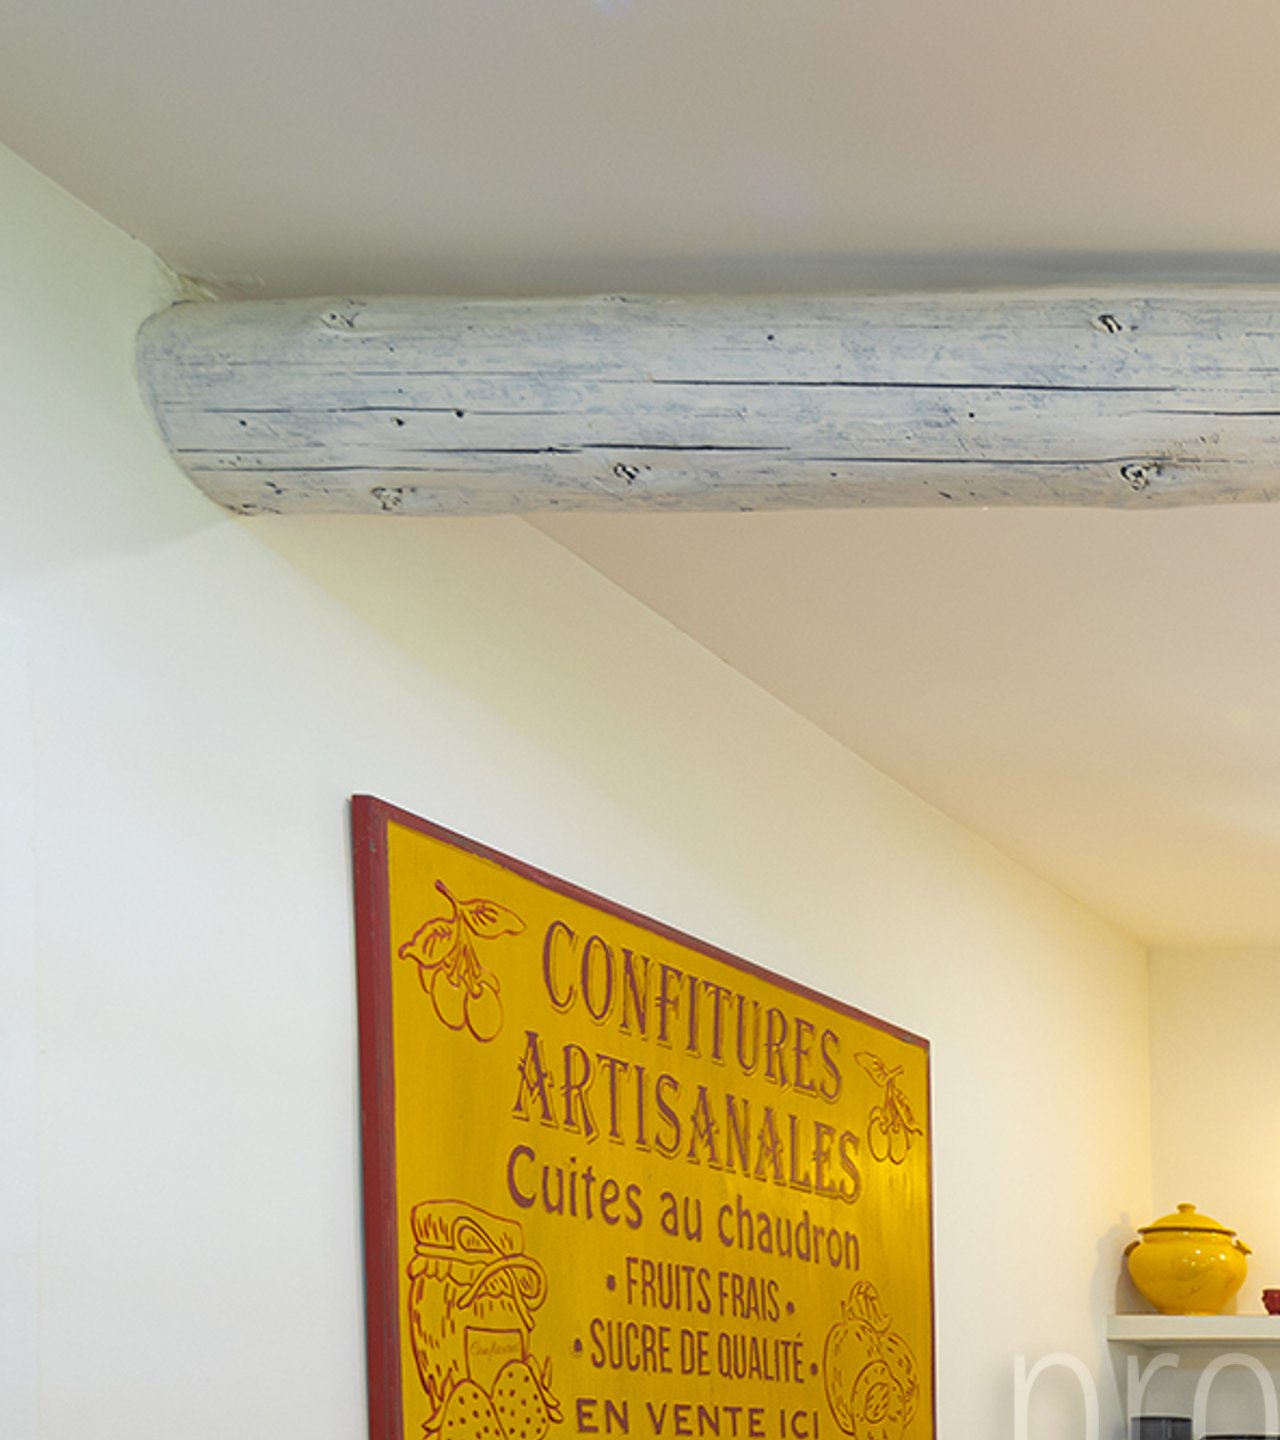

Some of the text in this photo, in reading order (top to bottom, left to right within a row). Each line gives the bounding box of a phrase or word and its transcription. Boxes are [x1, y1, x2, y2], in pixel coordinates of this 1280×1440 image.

[542, 920, 843, 1104] CONFITURES
[511, 1030, 863, 1204] ARTISANALES
[507, 1145, 860, 1272] Cuites au chaudron
[626, 1257, 781, 1322] FRUITS FRAIS
[589, 1318, 805, 1385] SUCRE DE QUALITÉ
[576, 1398, 820, 1440] EN VENTE ICI
